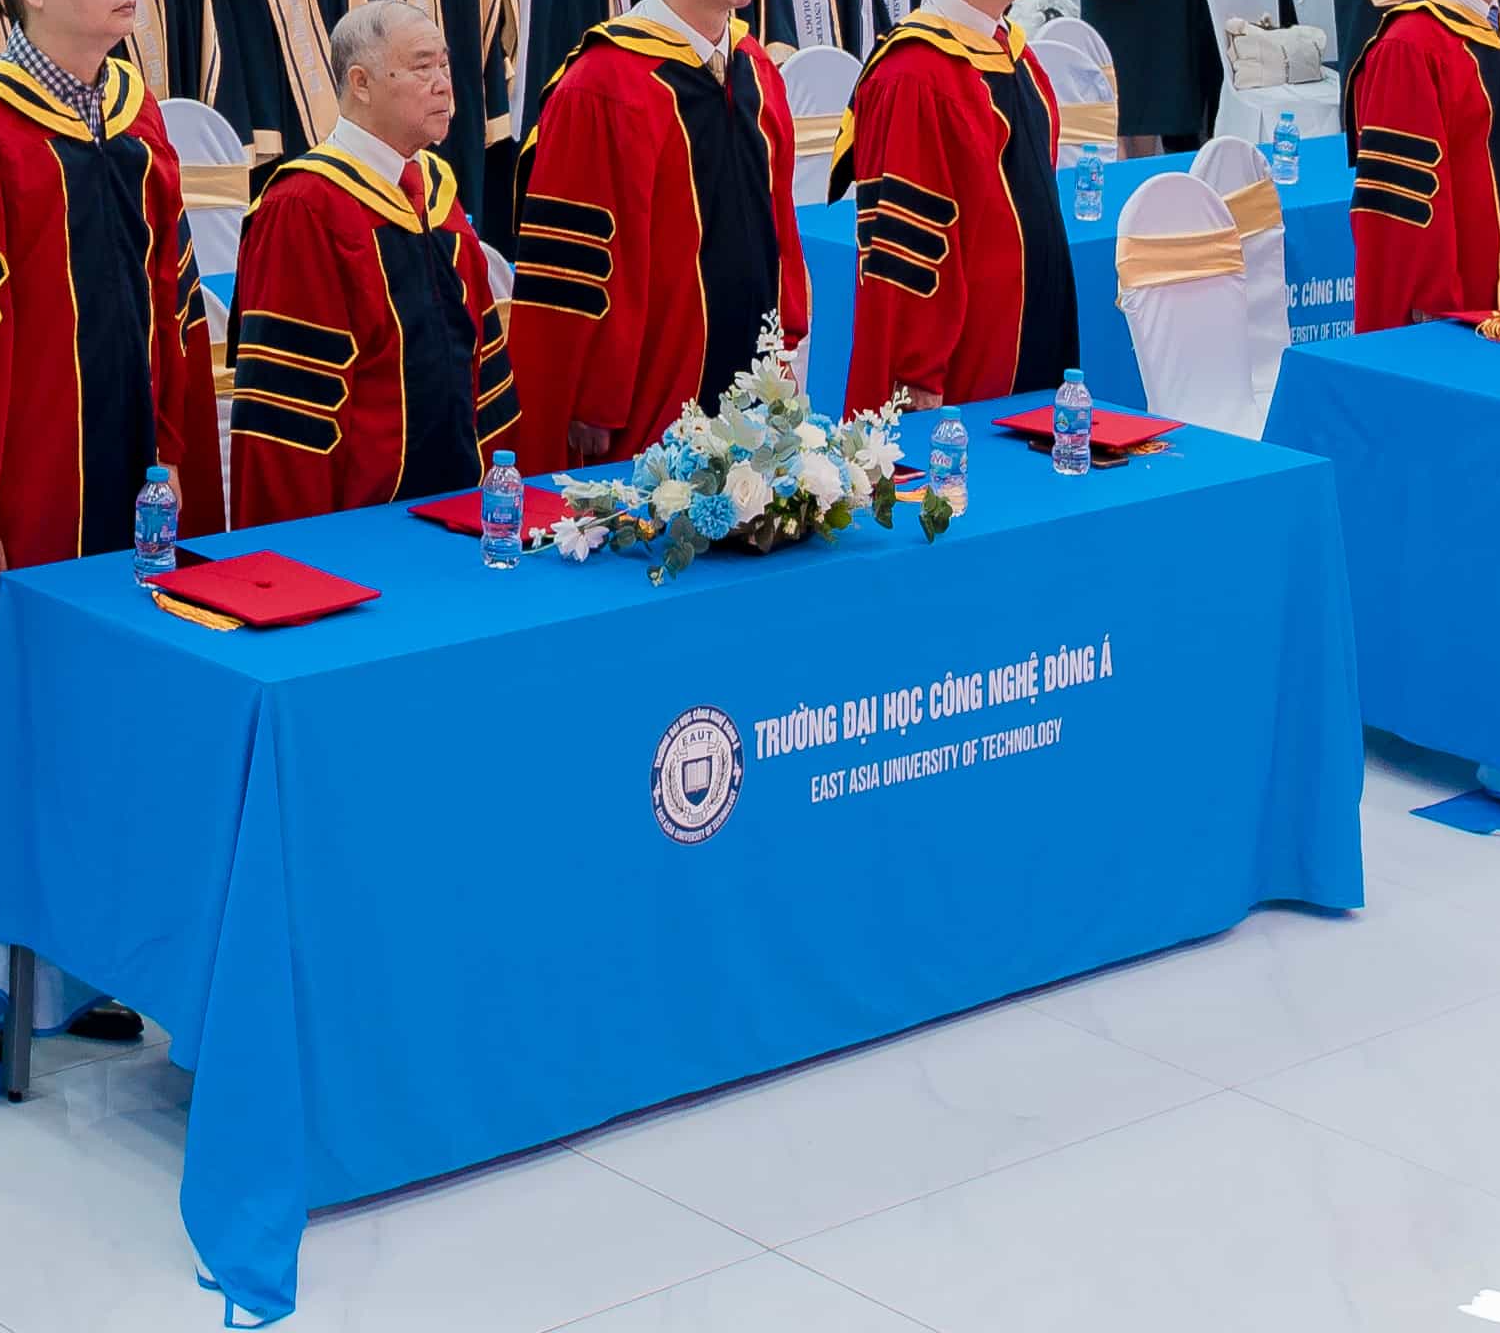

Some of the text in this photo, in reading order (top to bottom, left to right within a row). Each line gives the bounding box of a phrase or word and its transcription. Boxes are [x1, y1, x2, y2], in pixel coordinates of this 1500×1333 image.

[813, 2, 823, 45] UNIVERS
[1302, 277, 1333, 307] CÔNG
[1336, 277, 1355, 302] NG
[1291, 324, 1319, 343] ERSITY
[1321, 322, 1330, 340] OF
[755, 634, 1113, 759] TRƯỜNG ĐẠI HỌC CÔNG NGHỆ ĐÔNG Á
[682, 731, 713, 746] EAUT
[811, 718, 1062, 803] EAST ASIA UNIVERSITY OF TECHNOLOGY
